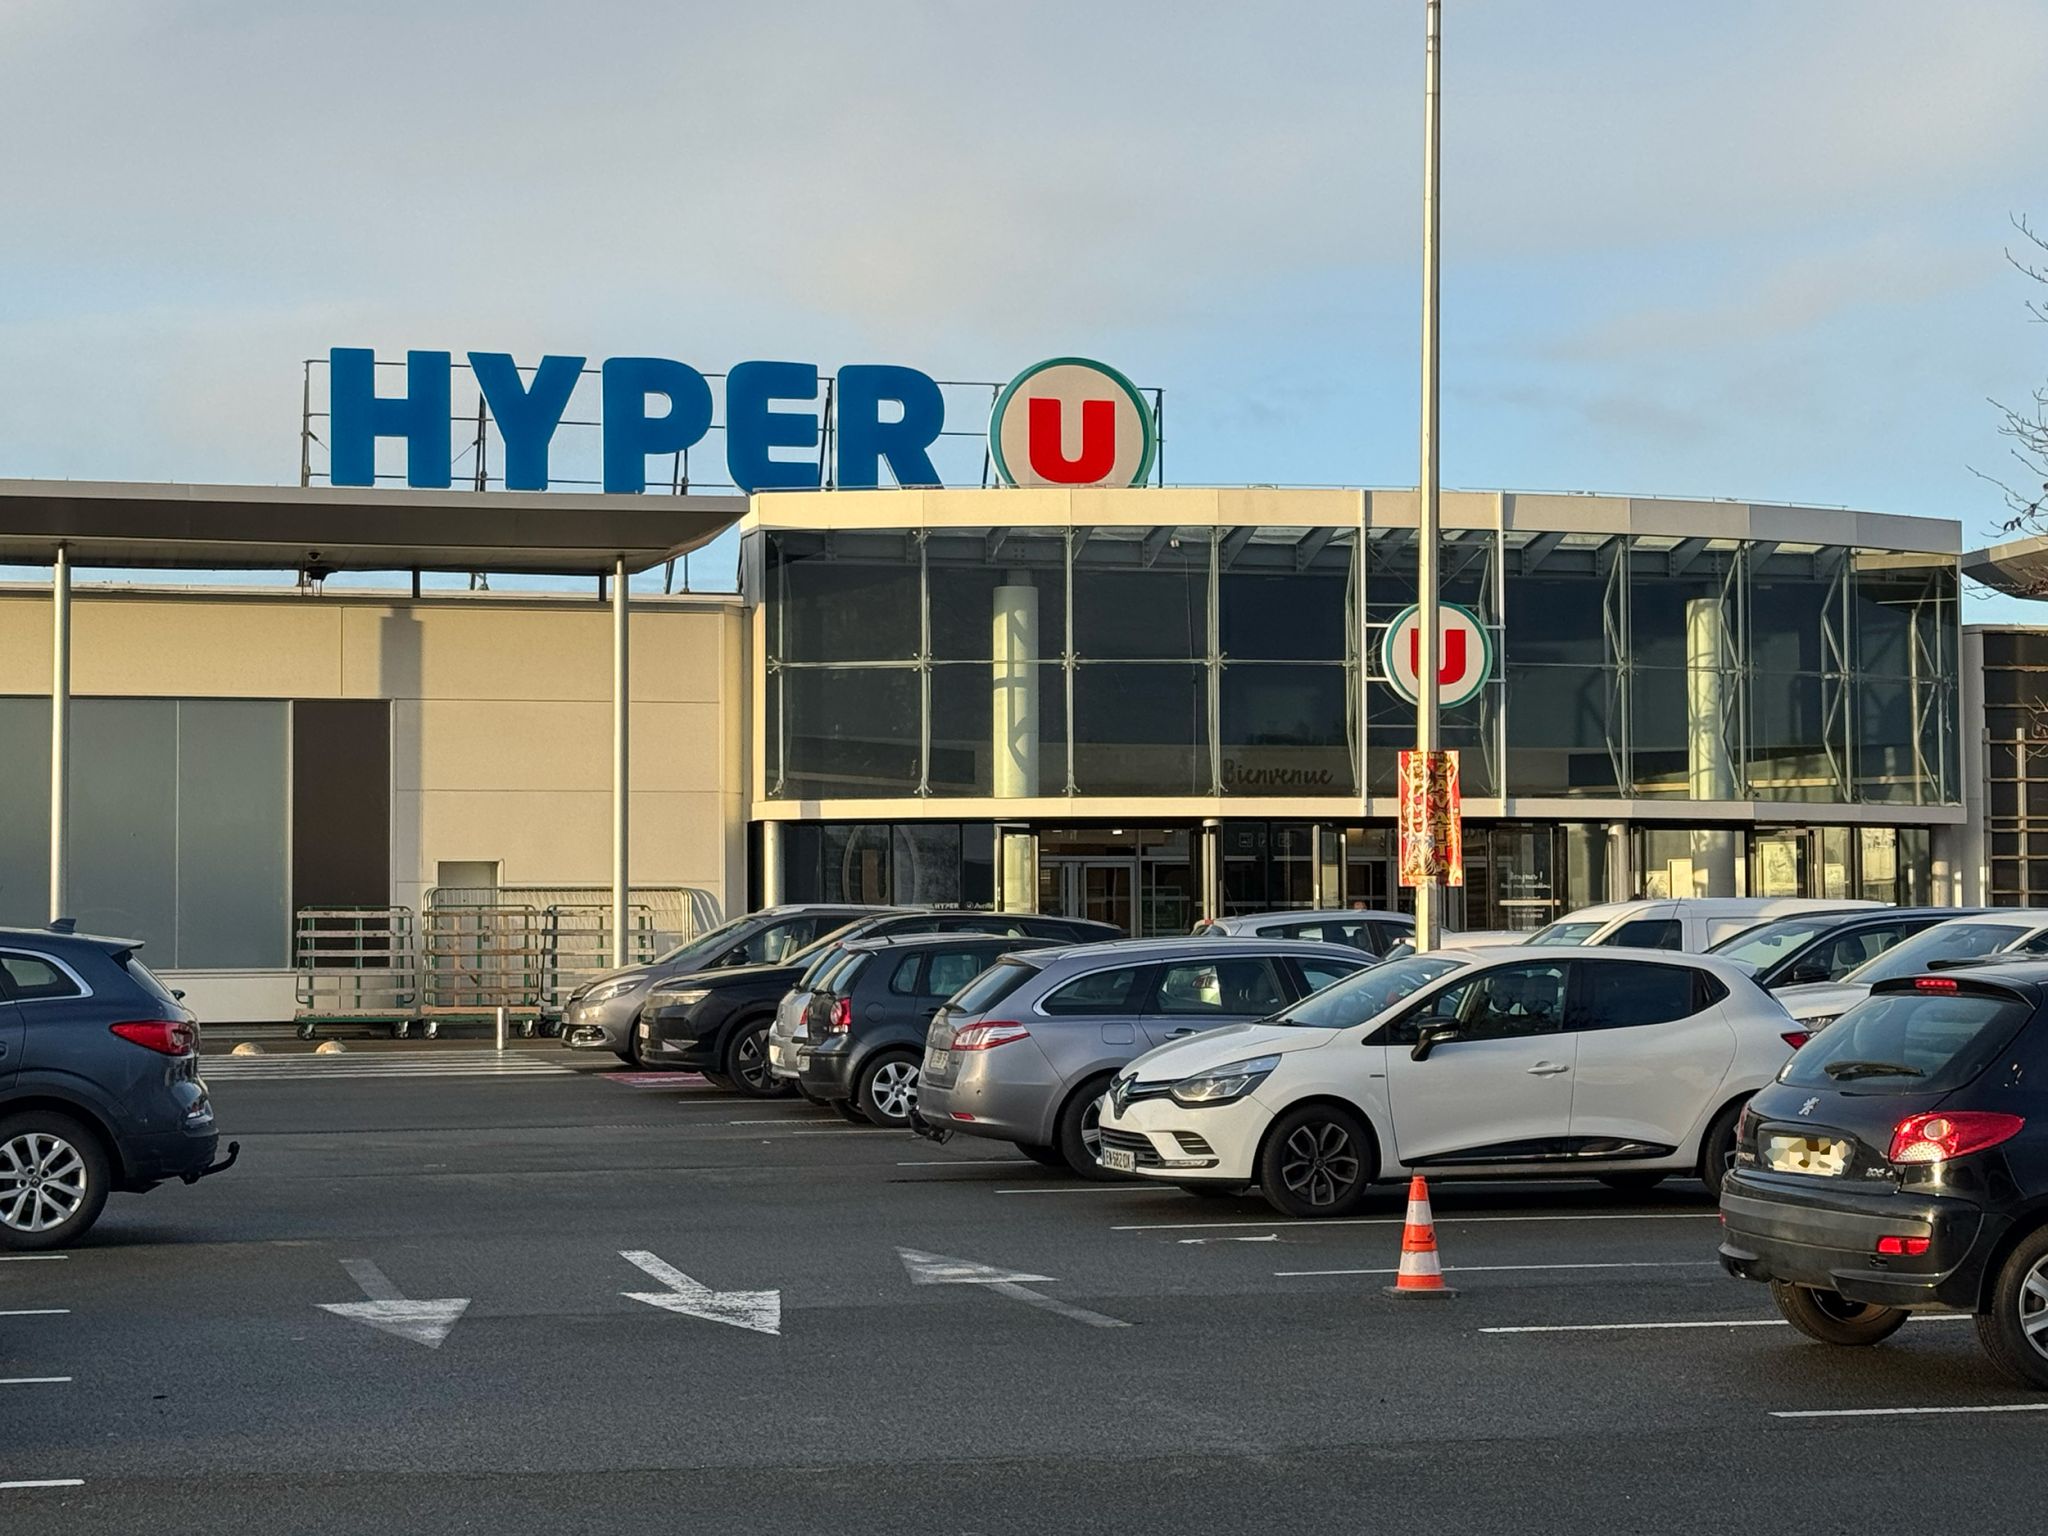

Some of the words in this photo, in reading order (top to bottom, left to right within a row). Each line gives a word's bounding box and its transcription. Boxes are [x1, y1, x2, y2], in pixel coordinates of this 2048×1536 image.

[330, 347, 944, 496] HYPER
[1029, 398, 1115, 484] U
[1410, 628, 1466, 685] U
[1223, 759, 1334, 785] Bienvenue
